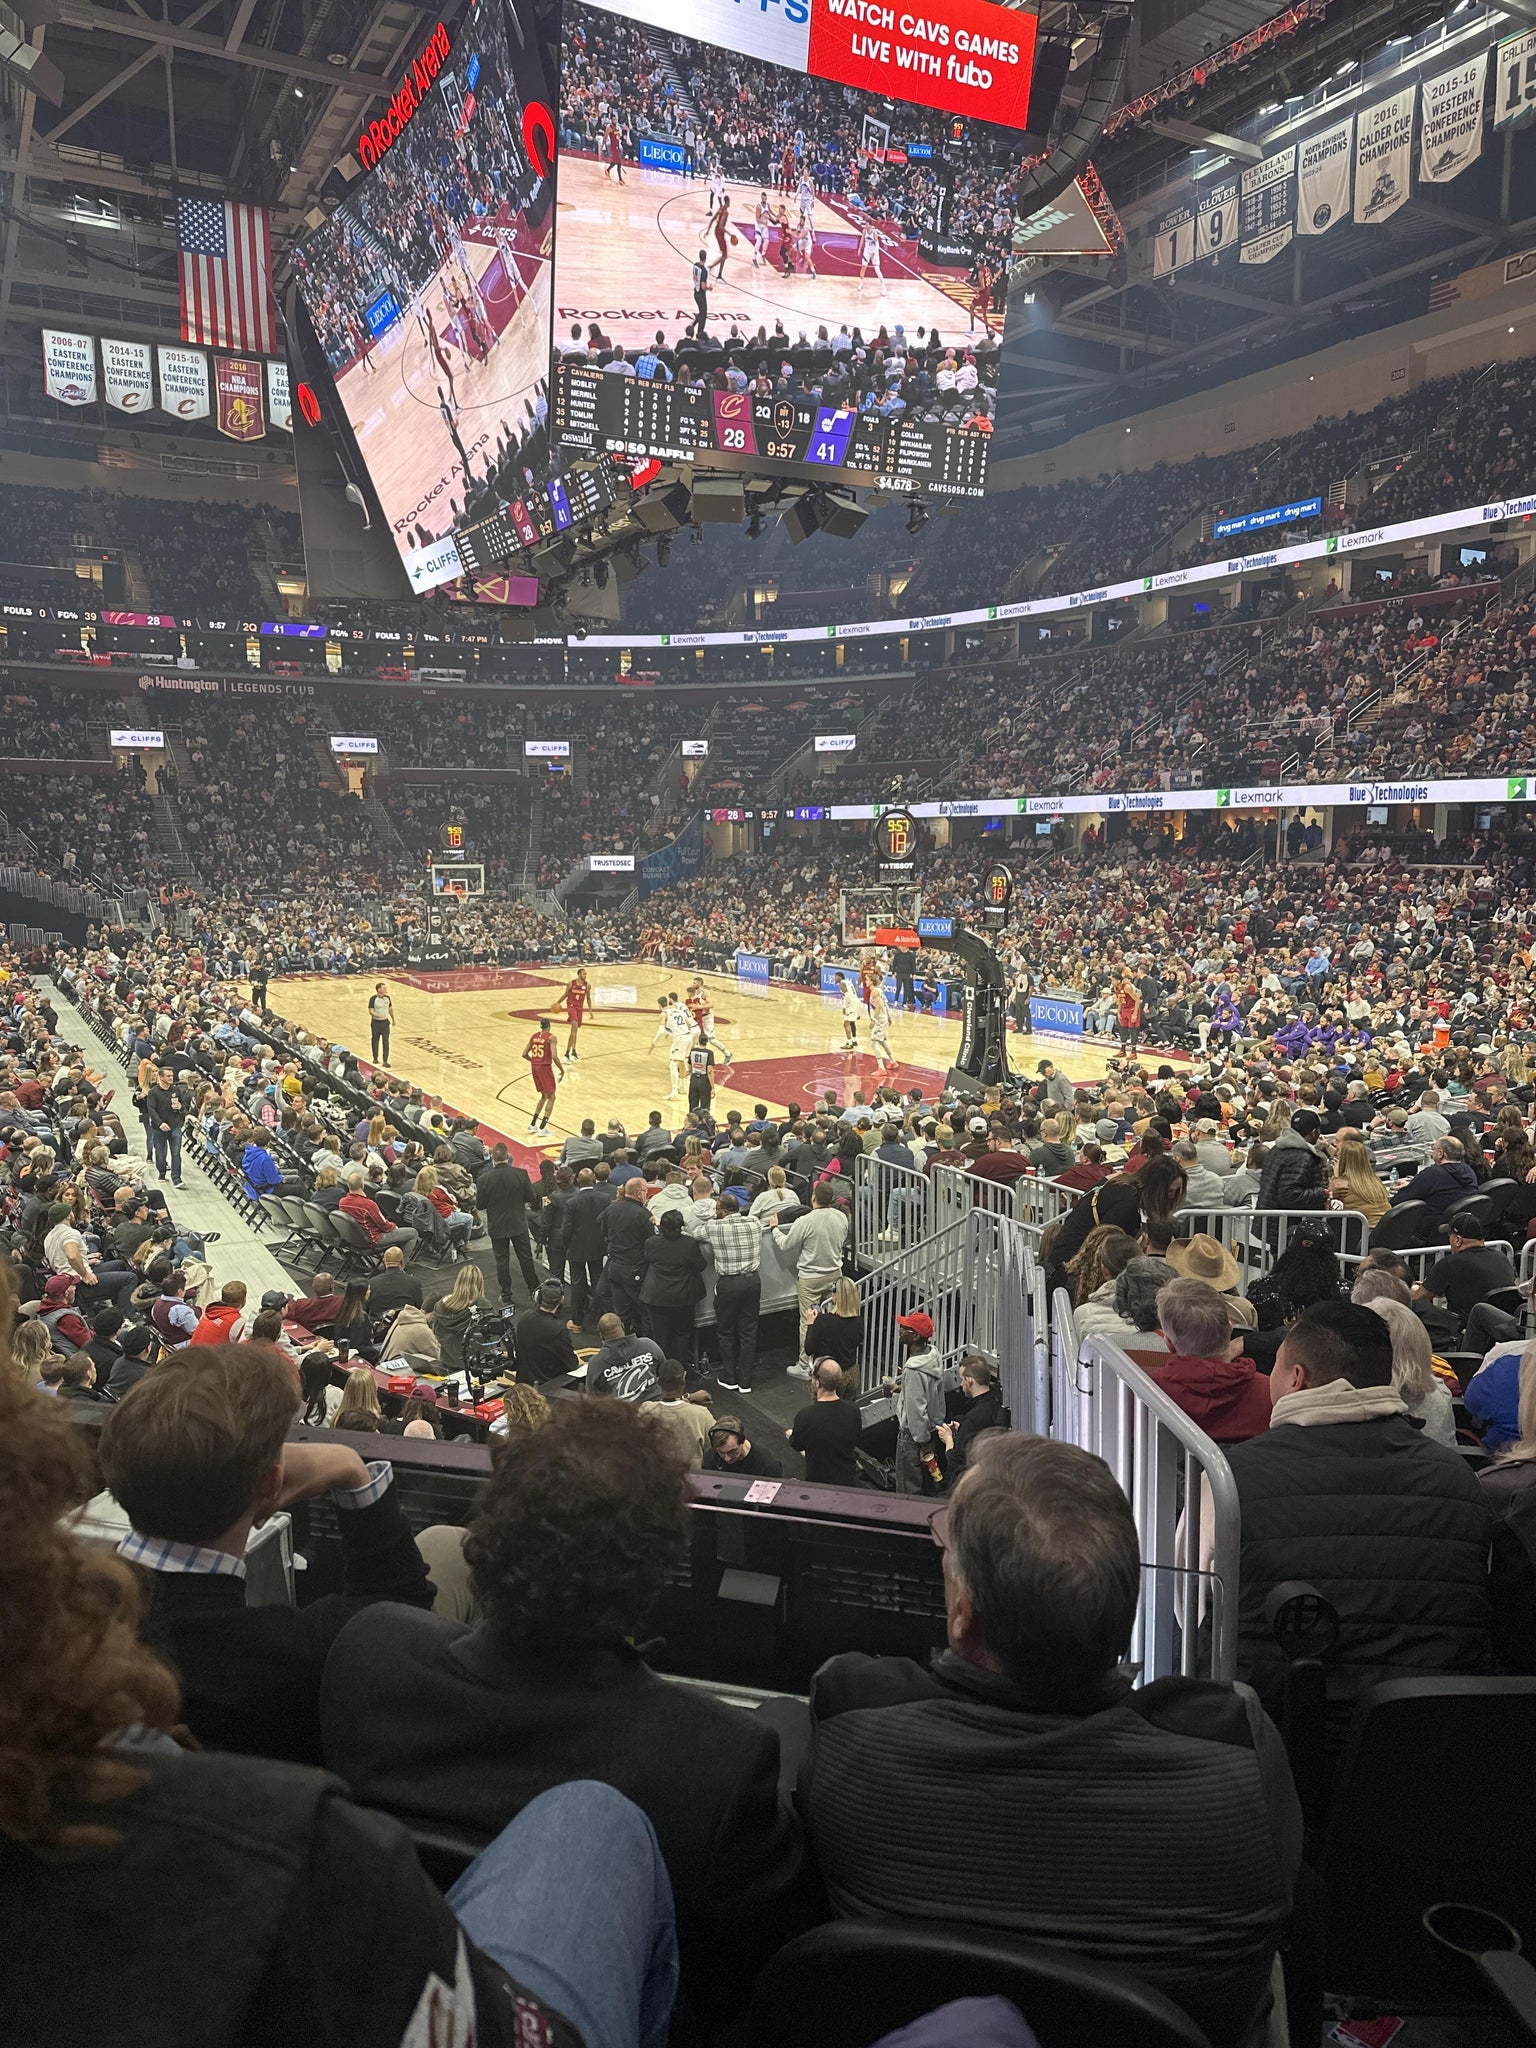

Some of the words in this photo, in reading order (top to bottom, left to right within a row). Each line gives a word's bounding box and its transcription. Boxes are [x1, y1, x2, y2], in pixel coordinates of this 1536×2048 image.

[828, 0, 894, 30] WATCH
[899, 15, 950, 46] CAVS
[954, 30, 1019, 64] GAMES
[1502, 40, 1536, 62] CALLA
[852, 34, 890, 63] LIVE
[895, 46, 941, 77] WITH
[947, 55, 993, 89] fubo
[1432, 68, 1477, 99] 2015-16
[369, 74, 418, 158] Rocket
[412, 22, 450, 101] Arena
[1432, 87, 1475, 117] WESTERN
[1374, 104, 1398, 125] 2016
[1424, 100, 1481, 136] CONFERENCE
[1360, 125, 1392, 151] CALDER
[1394, 114, 1411, 132] CUP
[1426, 117, 1477, 150] CHAMPIONS
[1322, 129, 1346, 149] DIVISION
[1302, 138, 1348, 169] CHAMPIONS
[1359, 130, 1410, 165] CHAMPIONS
[1243, 150, 1293, 182] CLEVELAND
[1250, 165, 1285, 188] BARONS
[1199, 187, 1236, 210] GLOVER
[1159, 210, 1190, 231] BOWER
[1210, 210, 1223, 248] 9
[938, 245, 960, 255] KeyBank
[1169, 230, 1177, 267] 1
[558, 308, 669, 320] Rocket
[674, 310, 751, 321] Aena
[51, 336, 87, 349] 2006-07
[53, 349, 87, 360] EASTERN
[109, 345, 144, 357] 2014-15
[111, 357, 143, 369] EASTERN
[165, 352, 200, 364] 2015-16
[48, 358, 94, 372] CONFERENCE
[168, 364, 199, 375] EASTERN
[230, 362, 247, 371] 2016
[50, 368, 93, 382] CHAMPIONS
[106, 366, 150, 380] CONFERENCE
[571, 369, 604, 380] CAVALIERS
[108, 376, 149, 389] CHAMPIONS
[163, 373, 206, 387] CONFERENCE
[231, 375, 246, 385] NBA
[570, 379, 597, 389] MOBLEY
[625, 377, 635, 385] PTS
[638, 380, 650, 388] REB
[164, 384, 205, 396] CHAMPIONS
[220, 382, 259, 395] CHAMPIONS
[570, 389, 597, 400] MERRILL
[684, 387, 702, 396] FOULS
[570, 400, 595, 409] HUNTER
[690, 396, 695, 404] 0
[570, 410, 593, 419] TOMLIN
[756, 406, 771, 418] 2Q
[798, 412, 810, 424] 18
[863, 415, 879, 423] FOULS
[570, 420, 599, 431] MITCHELL
[868, 423, 873, 431] 3
[562, 432, 593, 445] oswald
[724, 428, 745, 448] 28
[901, 431, 924, 440] COLLIER
[650, 446, 694, 460] RAFFLE
[767, 442, 796, 458] 9:57
[816, 443, 835, 461] 41
[900, 449, 930, 458] FILIPOWSKI
[393, 476, 450, 534] Rocket
[451, 434, 490, 477] Aena
[879, 477, 912, 491] $4,678
[928, 482, 984, 497] CAVS5050.COM
[1232, 520, 1246, 529] mart
[1265, 512, 1280, 520] mart
[1284, 508, 1299, 516] drug
[1300, 503, 1316, 512] mart
[1483, 507, 1498, 520] Blue
[1341, 530, 1384, 549] Lexmark
[426, 549, 459, 573] CLIFFS
[1228, 561, 1239, 572] Blue
[1244, 553, 1277, 570] Technologies
[1155, 572, 1188, 587] Lexmark
[1069, 596, 1078, 605] Blue
[1081, 589, 1108, 604] Technologies
[4, 606, 32, 616] FOULS
[39, 608, 46, 618] 0
[1000, 603, 1031, 616] Lexmark
[57, 611, 78, 620] FG%
[84, 611, 97, 621] 39
[147, 616, 160, 626] 28
[209, 621, 226, 630] 9:57
[243, 623, 258, 632] 2Q
[909, 619, 919, 629] Blue
[924, 616, 952, 628] Technologies
[273, 624, 284, 634] 41
[352, 631, 364, 639] 52
[838, 624, 870, 635] Lexmark
[375, 632, 400, 641] FOULS
[407, 632, 413, 641] 3
[444, 634, 451, 643] 5
[476, 635, 487, 643] PM
[673, 635, 705, 645] Lexmark
[744, 633, 753, 642] Blue
[758, 631, 788, 642] Technologies
[156, 676, 219, 693] Huntington
[231, 683, 282, 694] LEGENDS
[286, 684, 315, 695] CLUB
[130, 735, 161, 743] CLIFFS
[349, 741, 376, 749] CLIFFS
[1235, 788, 1283, 803] Lexmark
[1350, 787, 1366, 800] Blue
[1376, 785, 1428, 802] Technologies
[939, 803, 948, 815] Blue
[952, 802, 979, 816] Technologies
[1029, 800, 1063, 812] Lexmark
[1108, 797, 1121, 809] Blue
[1125, 795, 1163, 811] Technologies
[727, 810, 738, 819] 28
[761, 810, 778, 819] 9:57
[786, 810, 794, 818] 18
[800, 810, 809, 818] 41
[888, 820, 909, 832] 9:57
[450, 834, 461, 846] 18
[891, 833, 907, 853] 18
[593, 859, 632, 867] TRUSTEDSEC
[993, 888, 1003, 900] 18
[920, 922, 951, 932] LECOM
[738, 959, 768, 974] LECOM
[674, 1015, 685, 1025] 22
[532, 1045, 544, 1057] 35
[960, 1042, 971, 1066] Clinic
[694, 1054, 702, 1063] 81
